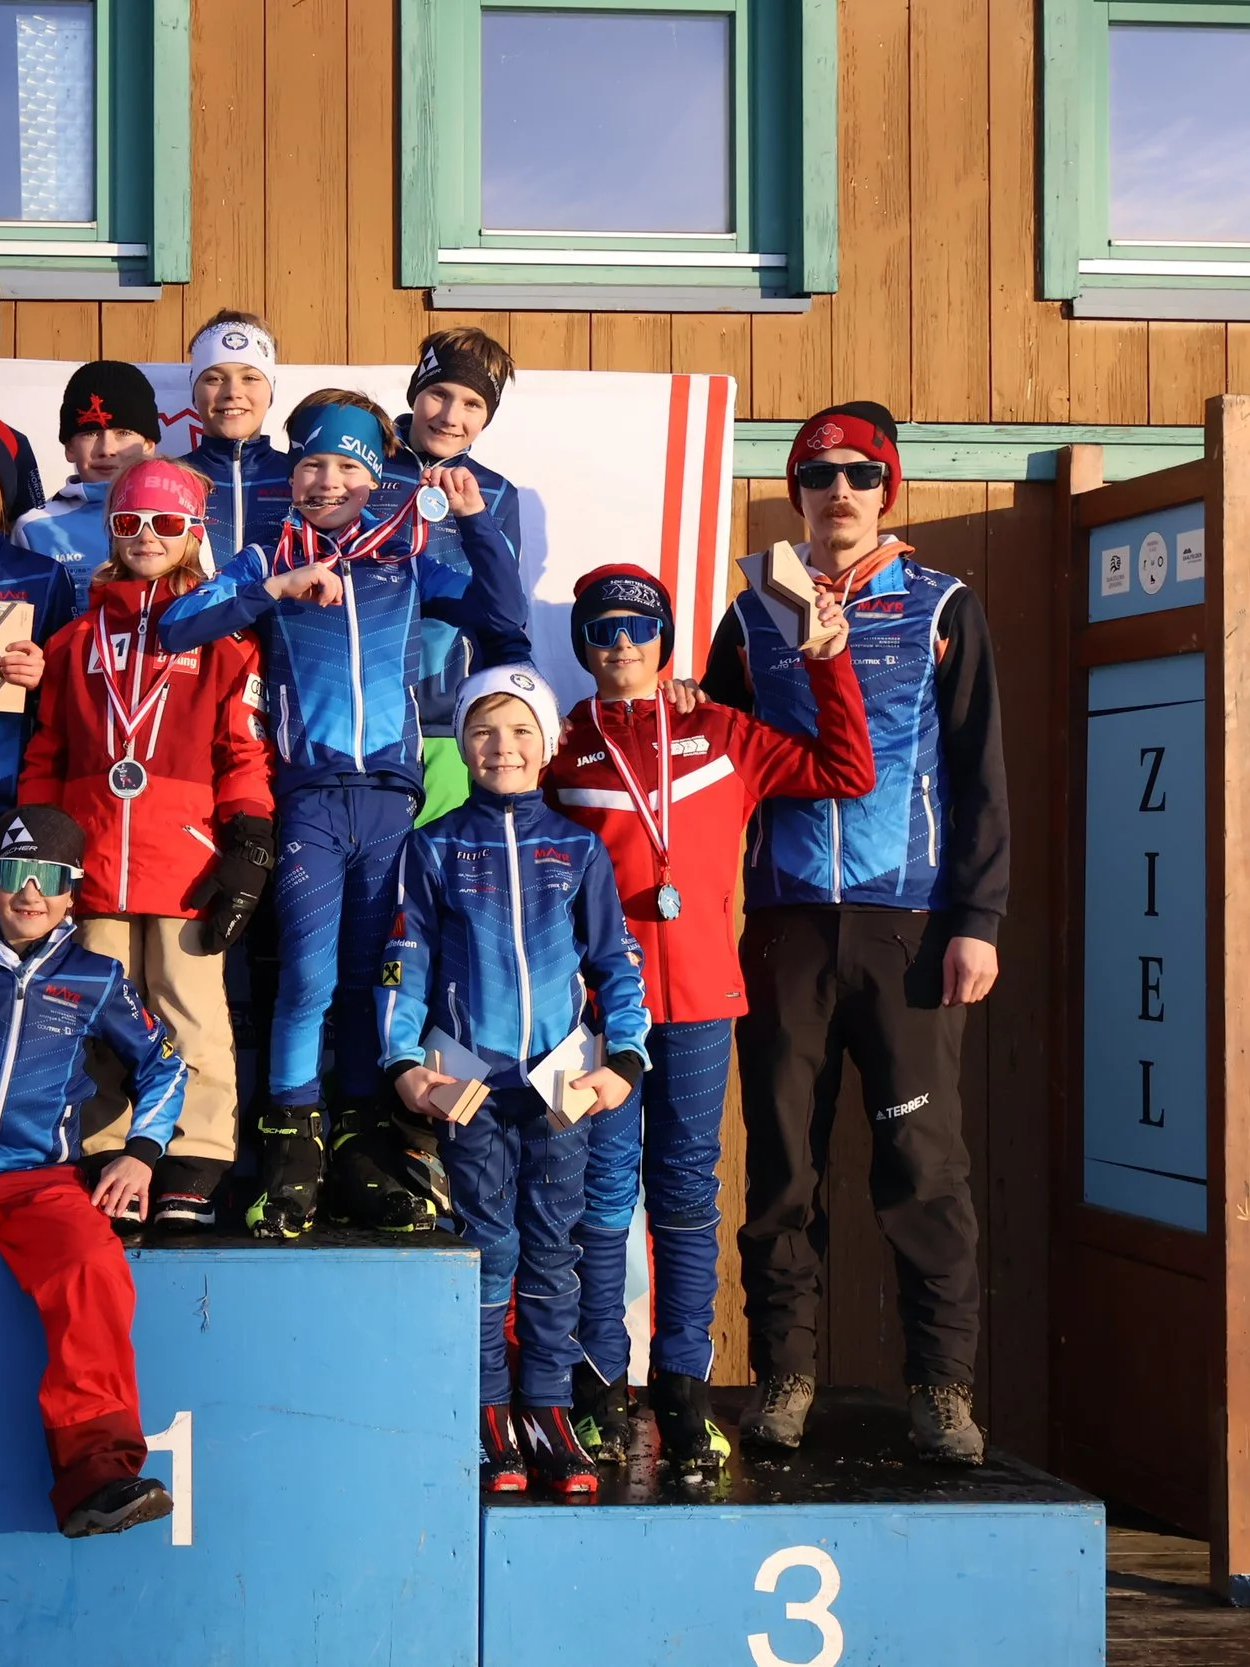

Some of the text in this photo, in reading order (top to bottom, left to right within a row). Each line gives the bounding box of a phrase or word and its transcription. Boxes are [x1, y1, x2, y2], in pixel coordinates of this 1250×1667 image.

[145, 476, 195, 500] BIKE
[856, 600, 904, 613] MAYR
[576, 751, 606, 767] JAKO
[1138, 747, 1166, 1128] ZIEL
[45, 984, 83, 1003] MAYR
[885, 1092, 929, 1119] TERREX
[146, 1411, 193, 1546] 1
[747, 1545, 844, 1667] 3
